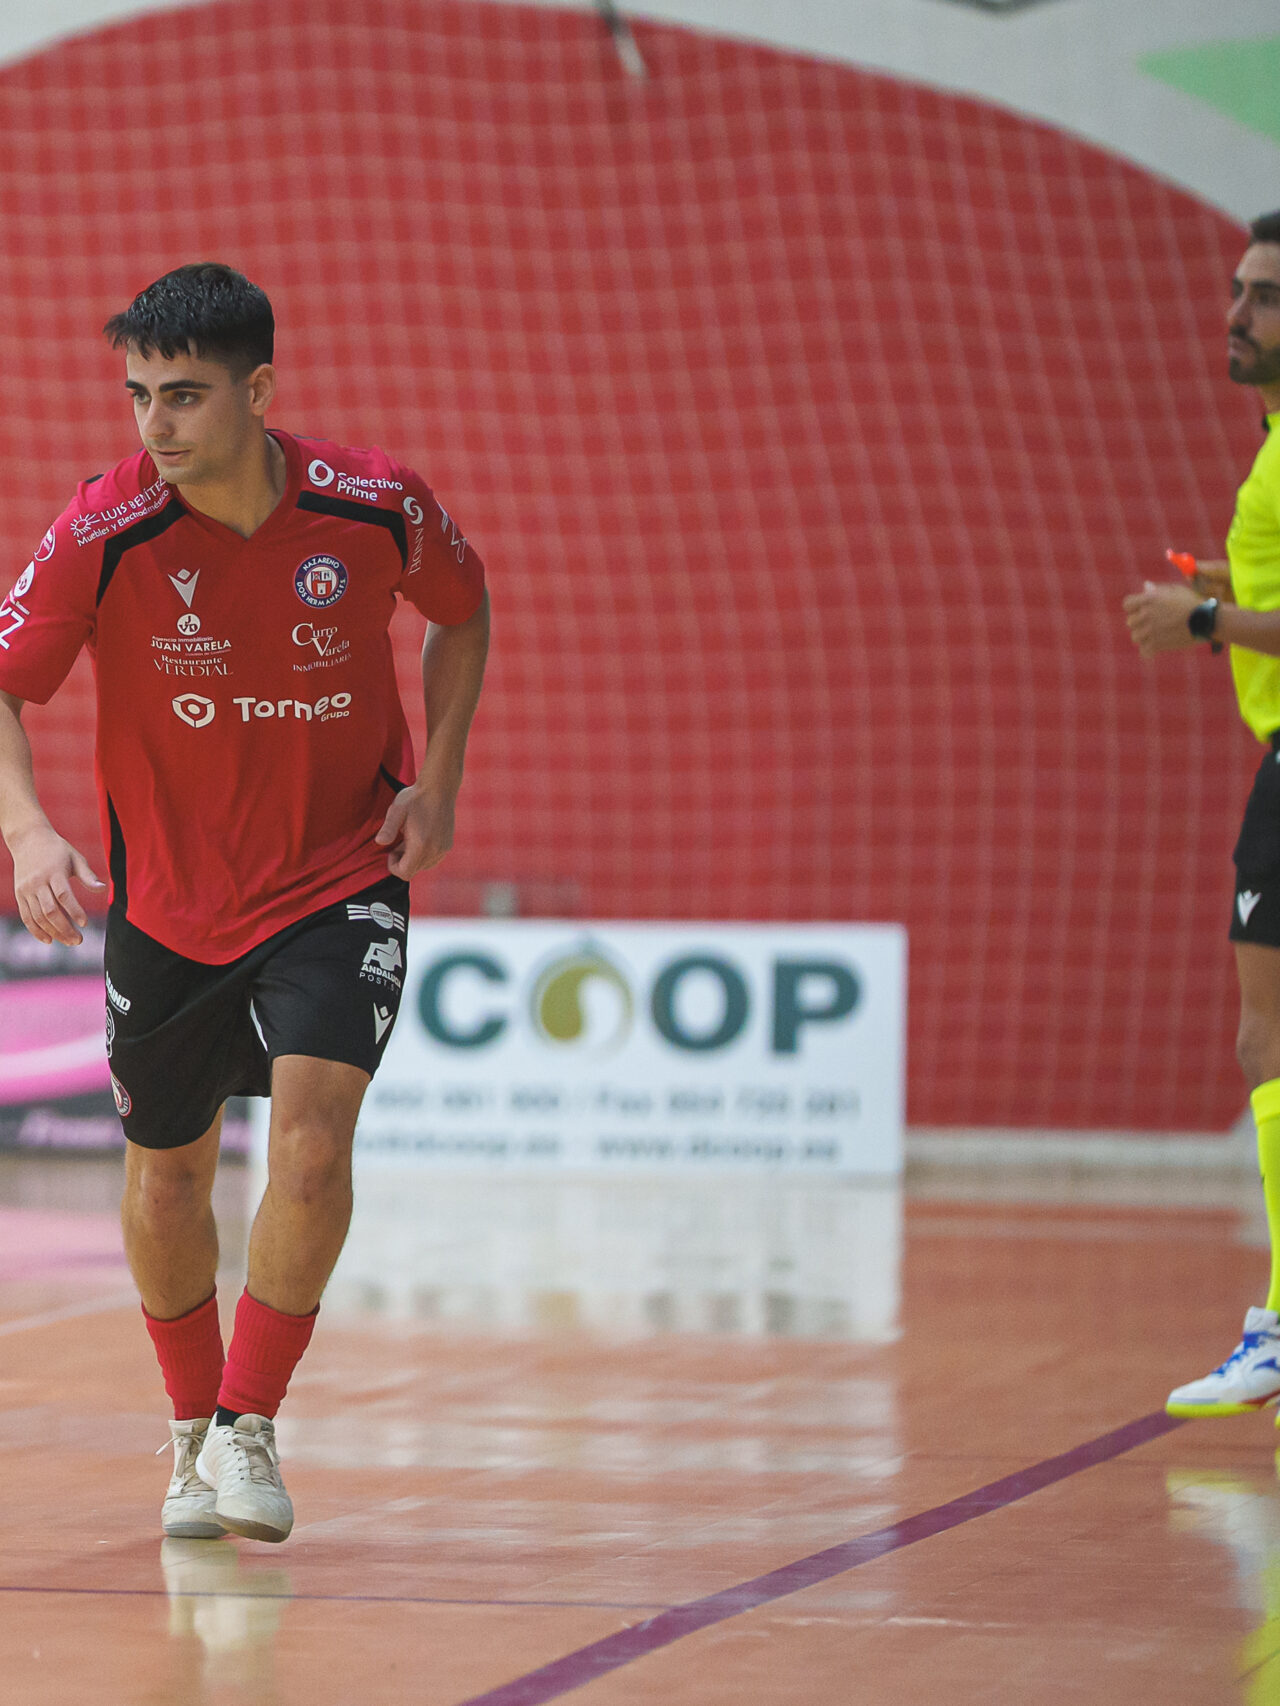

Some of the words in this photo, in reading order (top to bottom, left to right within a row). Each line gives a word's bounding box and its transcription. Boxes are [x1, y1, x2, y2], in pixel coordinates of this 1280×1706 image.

[336, 480, 378, 501] Prime
[337, 472, 403, 491] Colectivo
[101, 502, 128, 522] LUIS
[76, 526, 110, 547] Muebles
[110, 523, 118, 532] y
[302, 557, 340, 571] NAZARENO
[296, 581, 308, 598] DOS
[305, 589, 343, 606] HERMANAS
[291, 622, 338, 646] Curro
[151, 639, 181, 652] JUAN
[185, 639, 232, 652] VARELA
[310, 634, 351, 657] Varela
[161, 654, 223, 666] Restaurante
[233, 692, 352, 723] Torneo
[321, 709, 350, 722] Grupo
